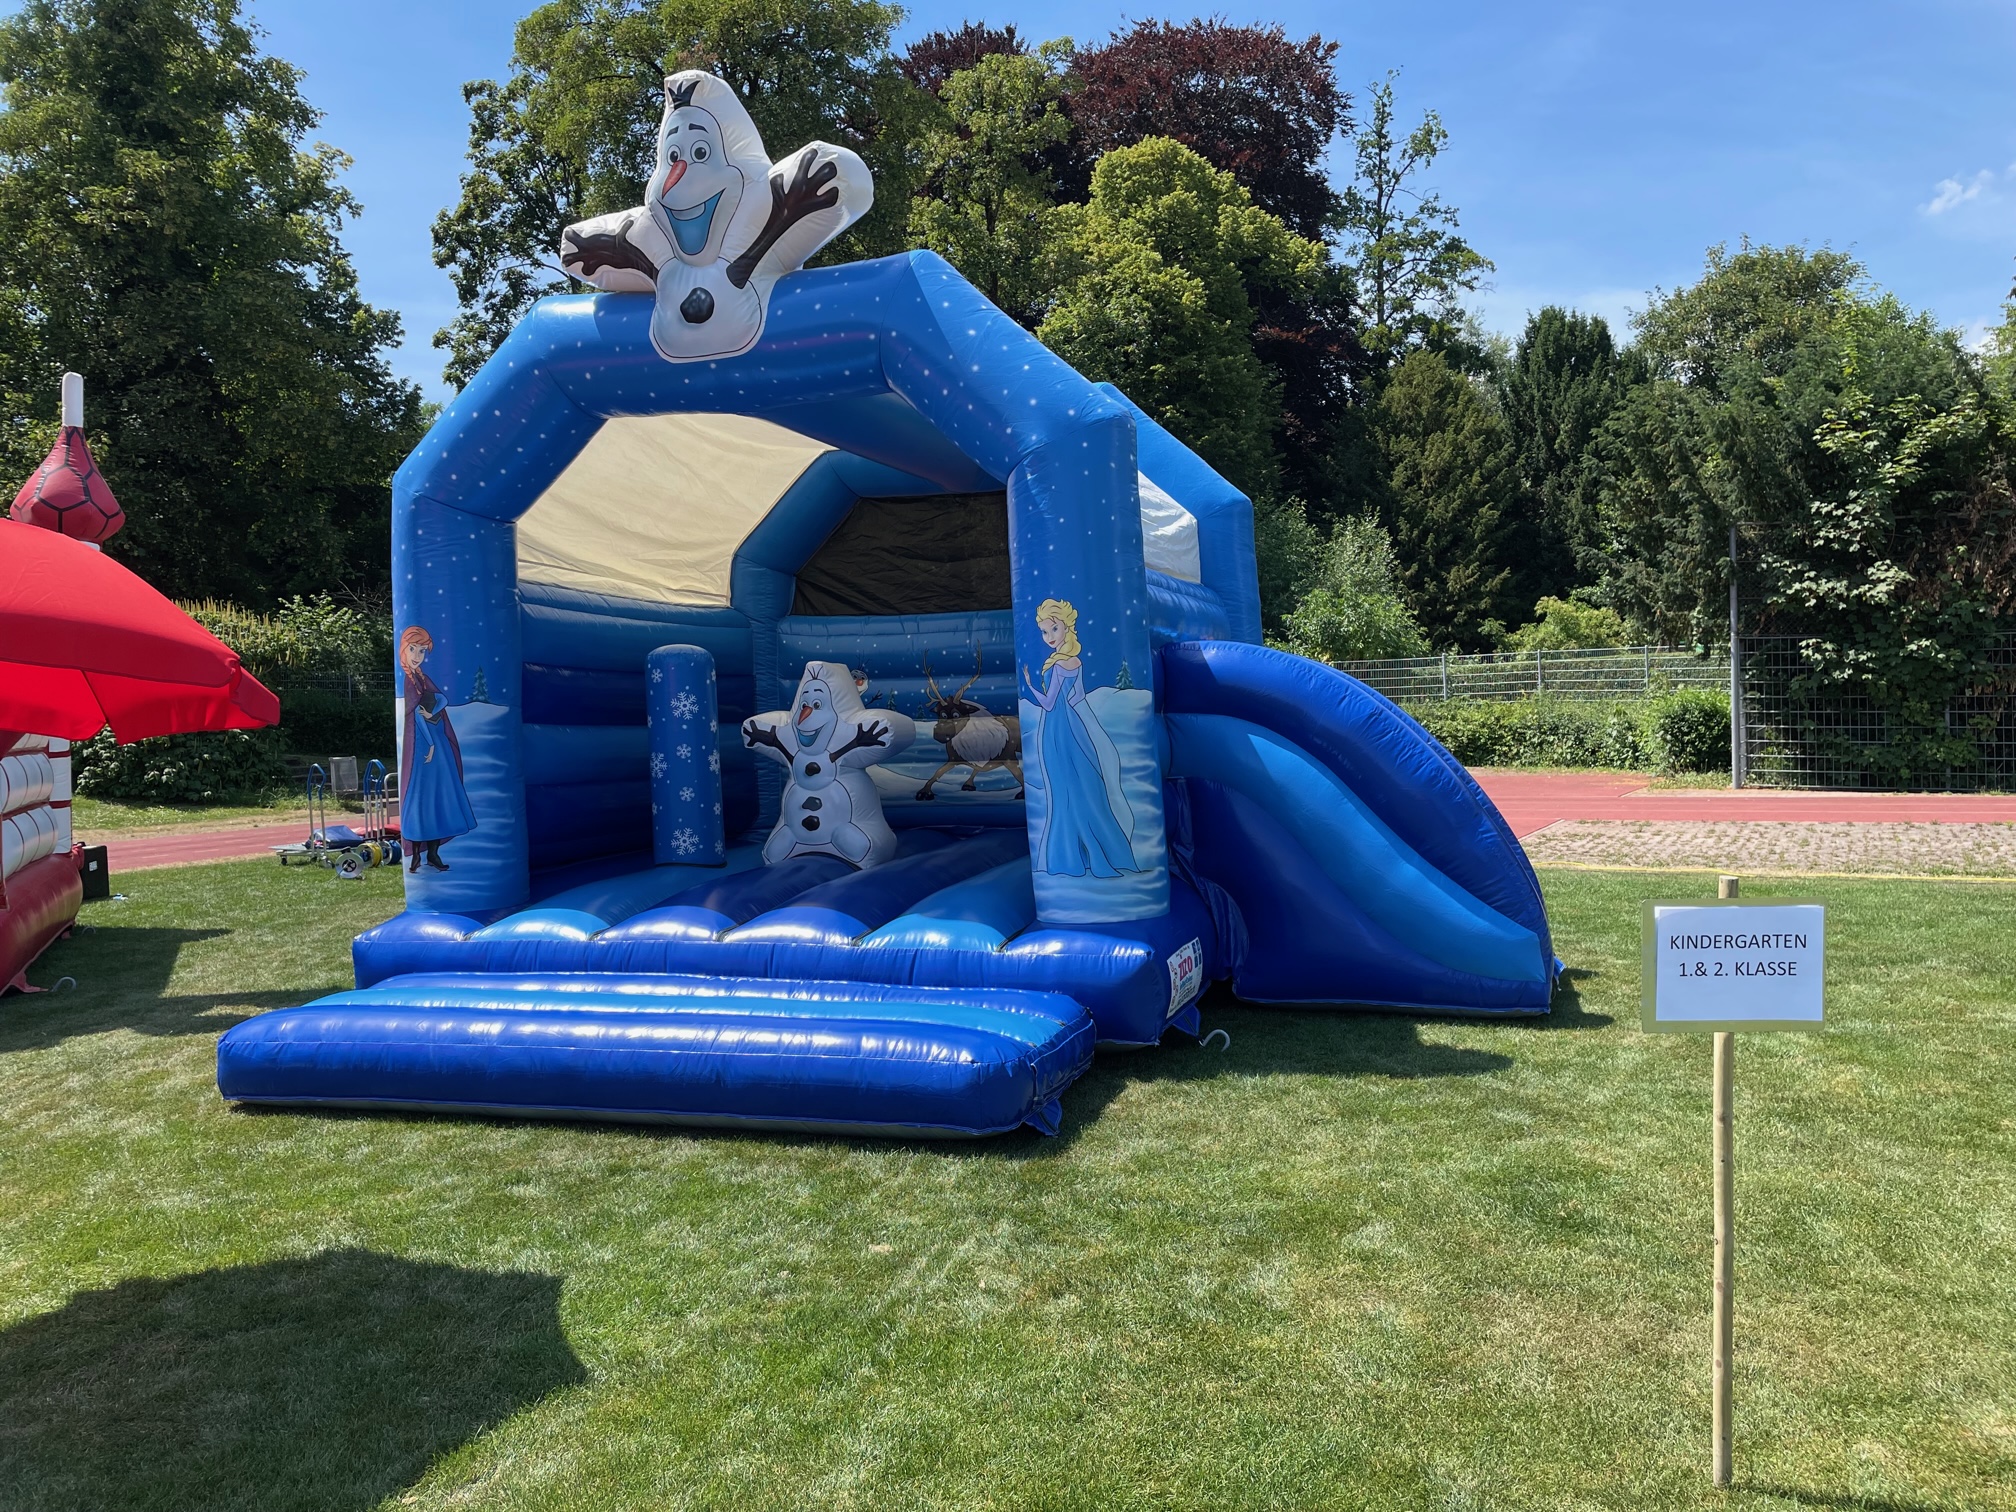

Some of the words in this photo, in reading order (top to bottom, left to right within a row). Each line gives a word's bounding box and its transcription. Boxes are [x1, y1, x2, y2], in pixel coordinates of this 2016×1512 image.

[1670, 934, 1807, 950] KINDERGARTEN
[1713, 962, 1729, 977] 2.
[1735, 961, 1798, 976] KLASSE
